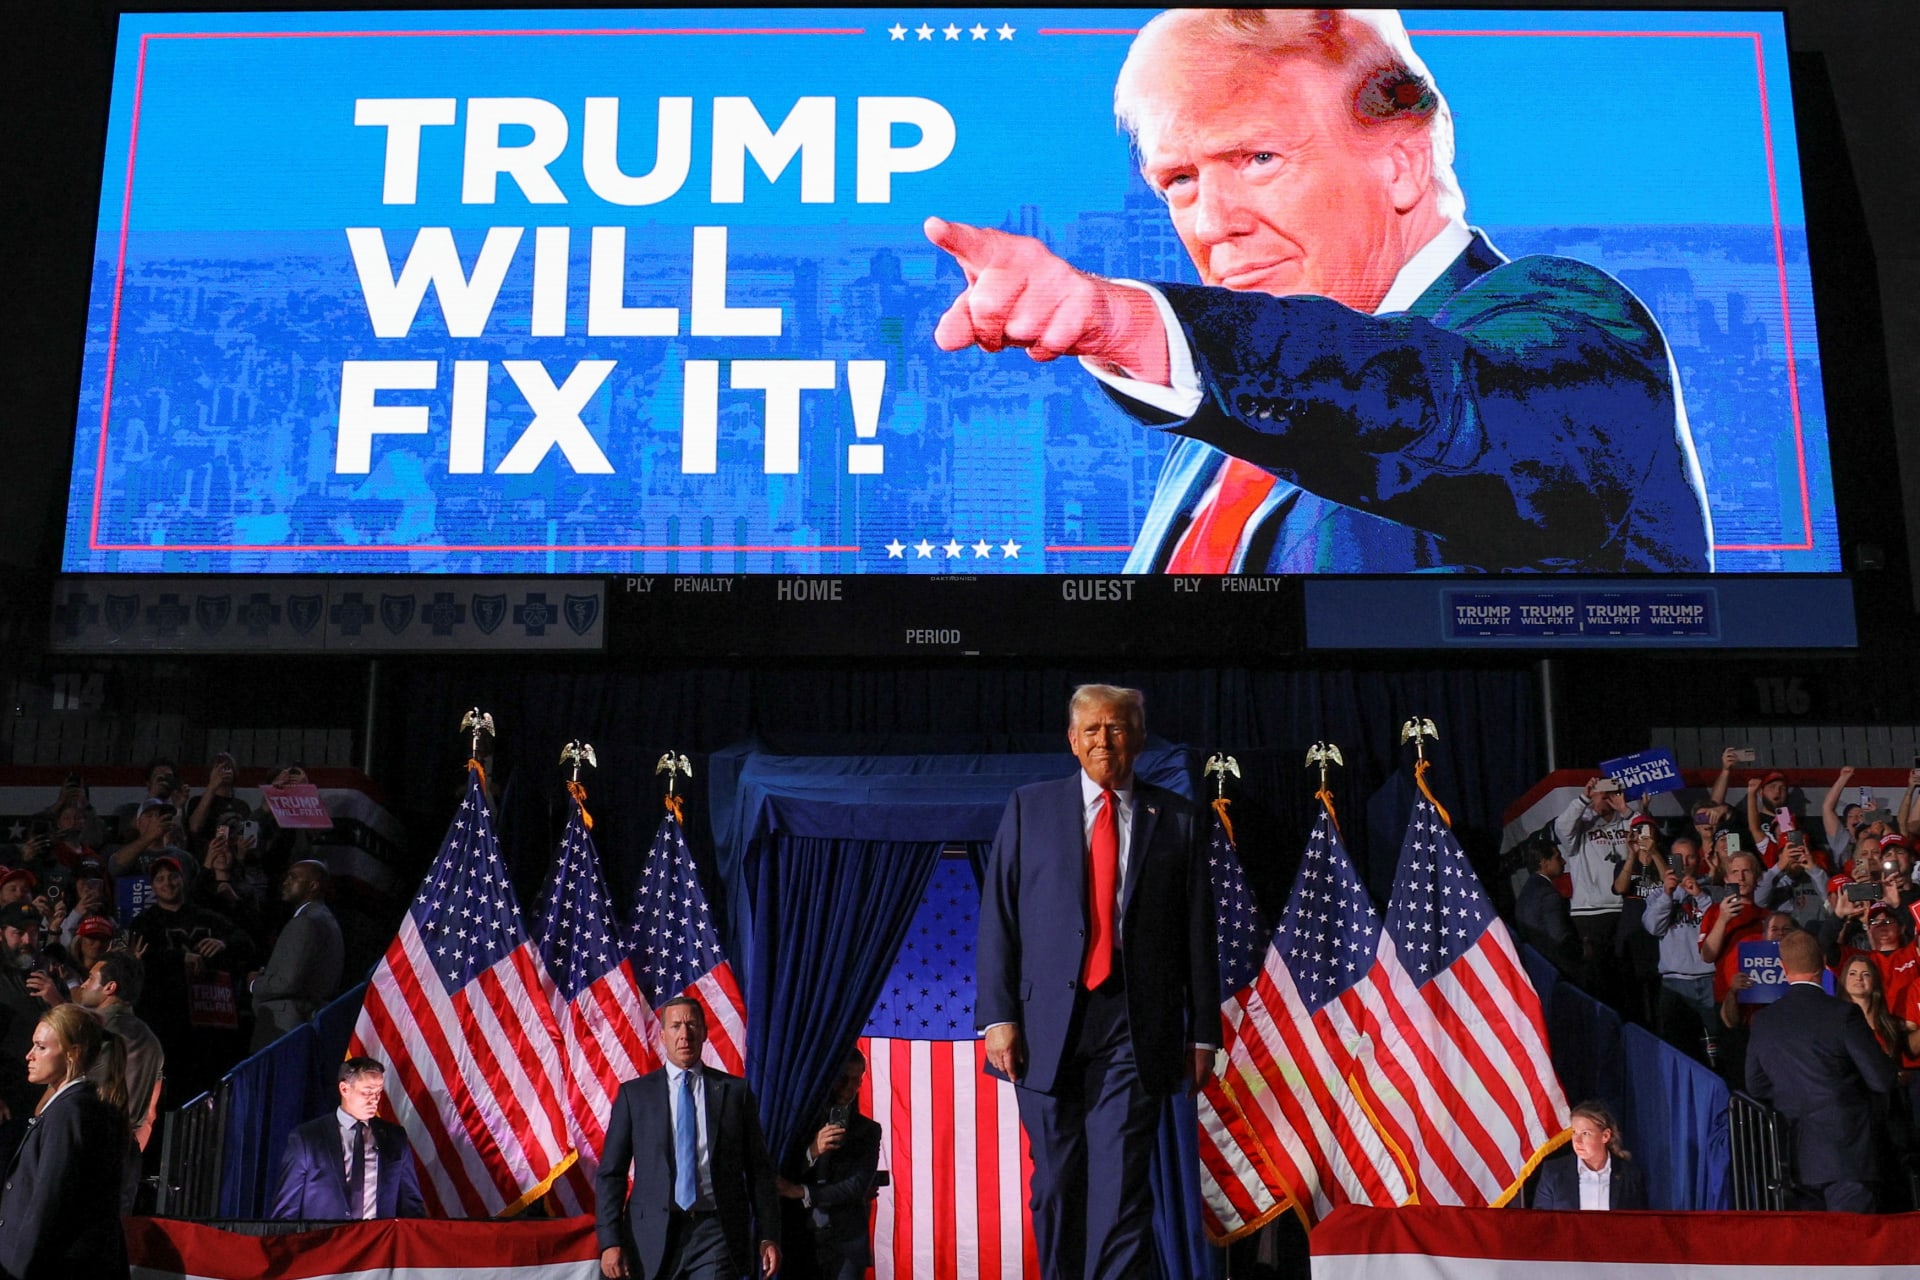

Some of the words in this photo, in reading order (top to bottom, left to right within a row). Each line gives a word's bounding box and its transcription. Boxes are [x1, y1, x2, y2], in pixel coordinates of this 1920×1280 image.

[354, 96, 956, 206] TRUMP
[345, 226, 782, 338] WILL
[335, 360, 618, 475] FIX
[681, 360, 886, 475] IT!
[626, 578, 654, 592] PLY
[674, 578, 734, 592] PENALTY
[777, 579, 842, 601] HOME
[1062, 579, 1136, 601] GUEST
[1174, 578, 1201, 592] PLY
[1221, 578, 1281, 592] PENALTY
[1456, 606, 1511, 617] TRUMP
[1520, 605, 1575, 617] TRUMP
[1586, 605, 1640, 617] TRUMP
[1648, 605, 1704, 617] TRUMP
[1457, 617, 1482, 625] WILL
[1484, 617, 1499, 625] FIX
[1501, 617, 1511, 625] IT
[1521, 617, 1546, 625] WILL
[1548, 617, 1563, 625] FIX
[1565, 617, 1574, 625] IT
[1587, 617, 1612, 625] WILL
[1614, 617, 1629, 625] FIX
[1631, 617, 1640, 625] IT
[1650, 617, 1675, 625] WILL
[1677, 617, 1692, 625] FIX
[1694, 617, 1704, 625] IT
[906, 629, 961, 644] PERIOD
[1623, 765, 1640, 776] FIX
[1641, 758, 1670, 771] WILL
[269, 796, 320, 809] TRUMP
[1744, 957, 1781, 968] DREA
[1749, 970, 1789, 984] AGA
